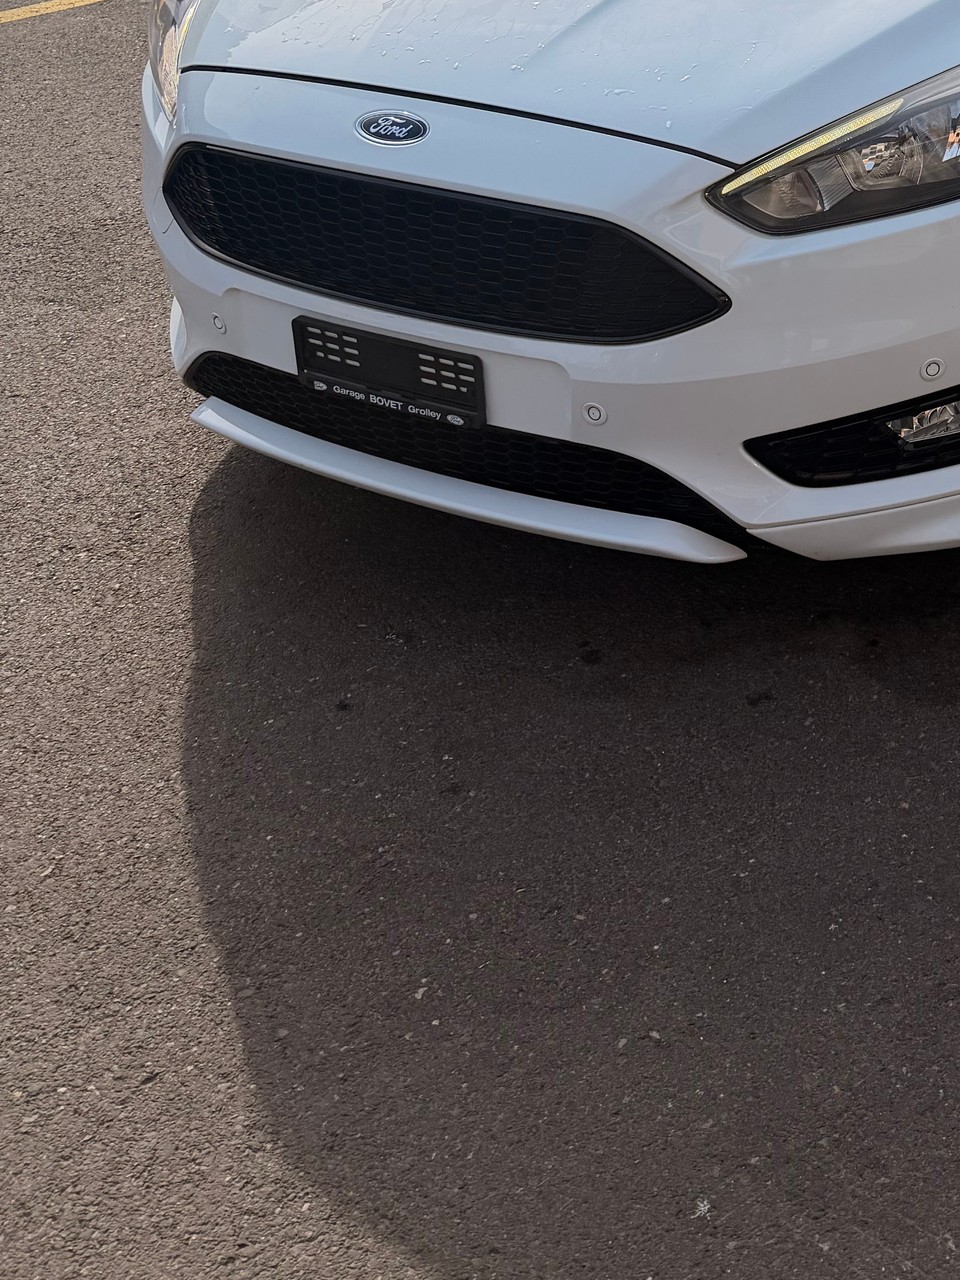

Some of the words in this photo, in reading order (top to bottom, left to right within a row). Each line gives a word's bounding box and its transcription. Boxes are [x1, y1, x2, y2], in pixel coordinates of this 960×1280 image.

[369, 116, 413, 137] Ford
[333, 385, 366, 400] Garage
[369, 393, 403, 411] BOVET
[407, 405, 441, 420] Grolley
